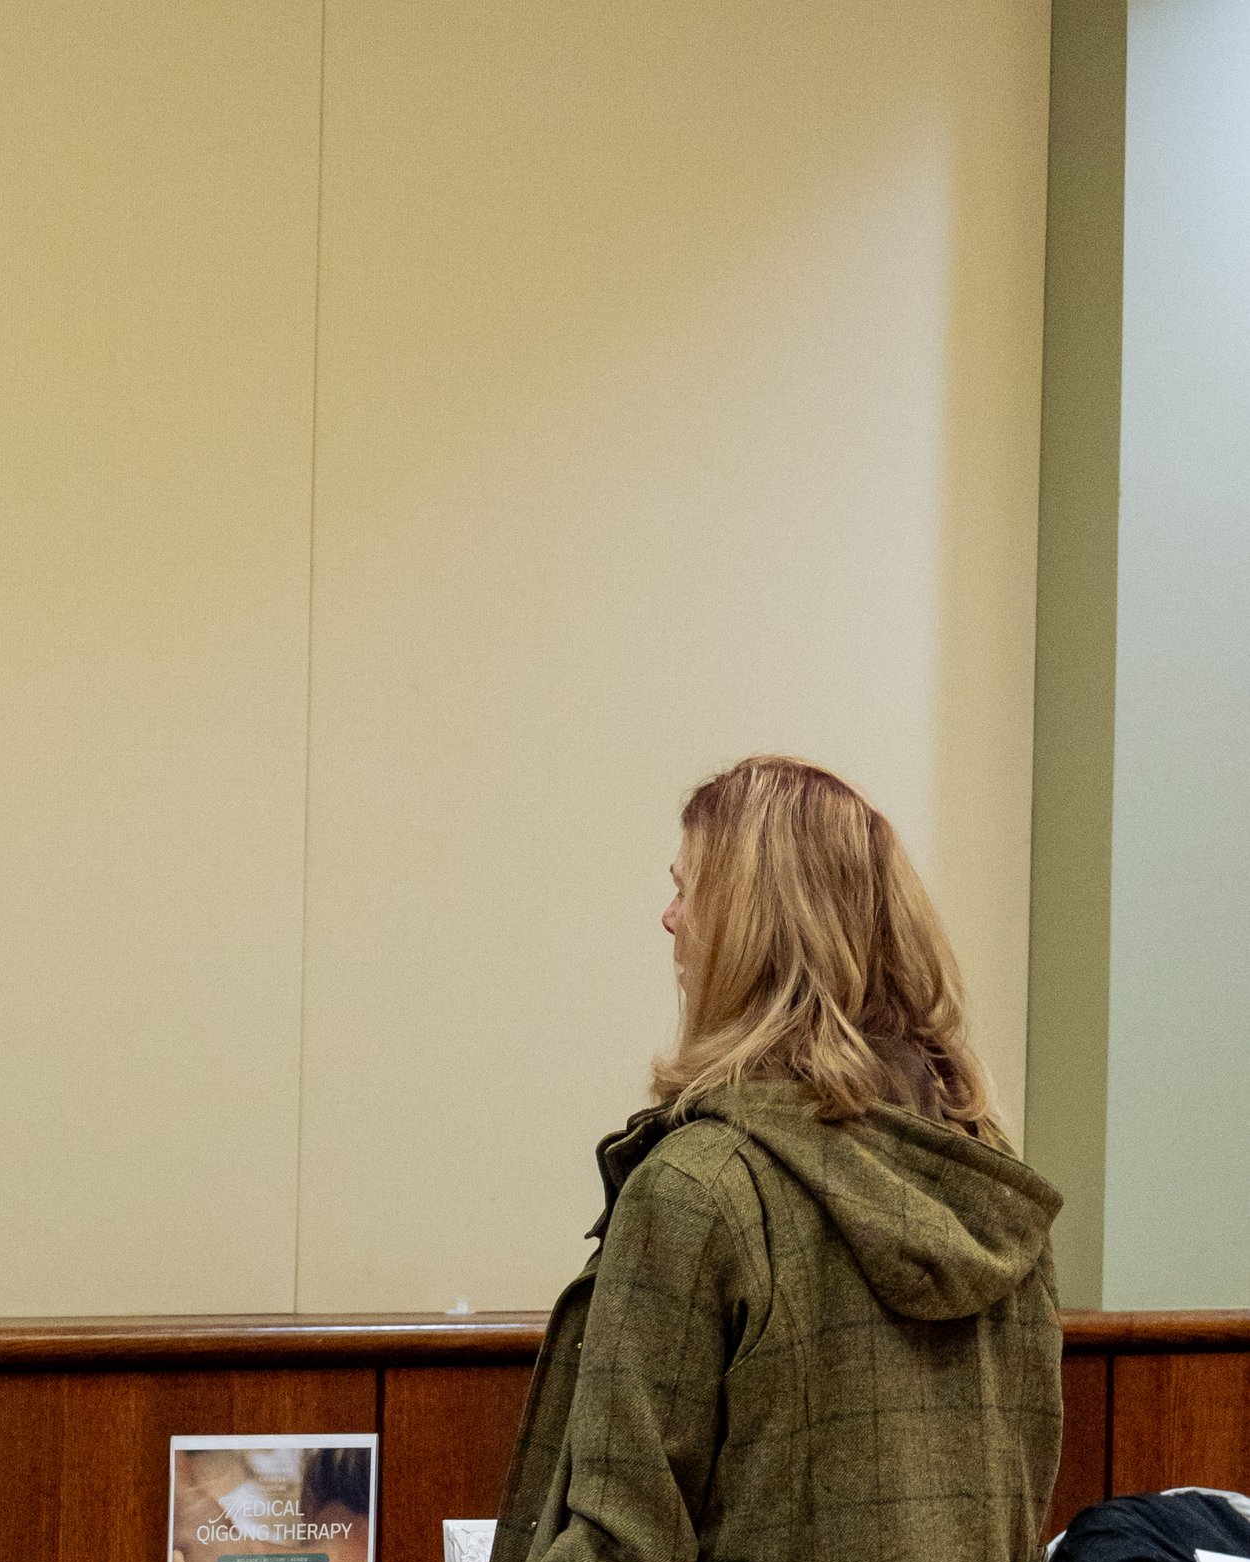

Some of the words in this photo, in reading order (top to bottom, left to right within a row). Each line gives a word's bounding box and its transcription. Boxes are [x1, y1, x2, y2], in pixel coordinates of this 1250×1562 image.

[208, 1496, 305, 1524] MEDICAL
[196, 1525, 269, 1545] QIGONG
[273, 1523, 353, 1541] THERAPY
